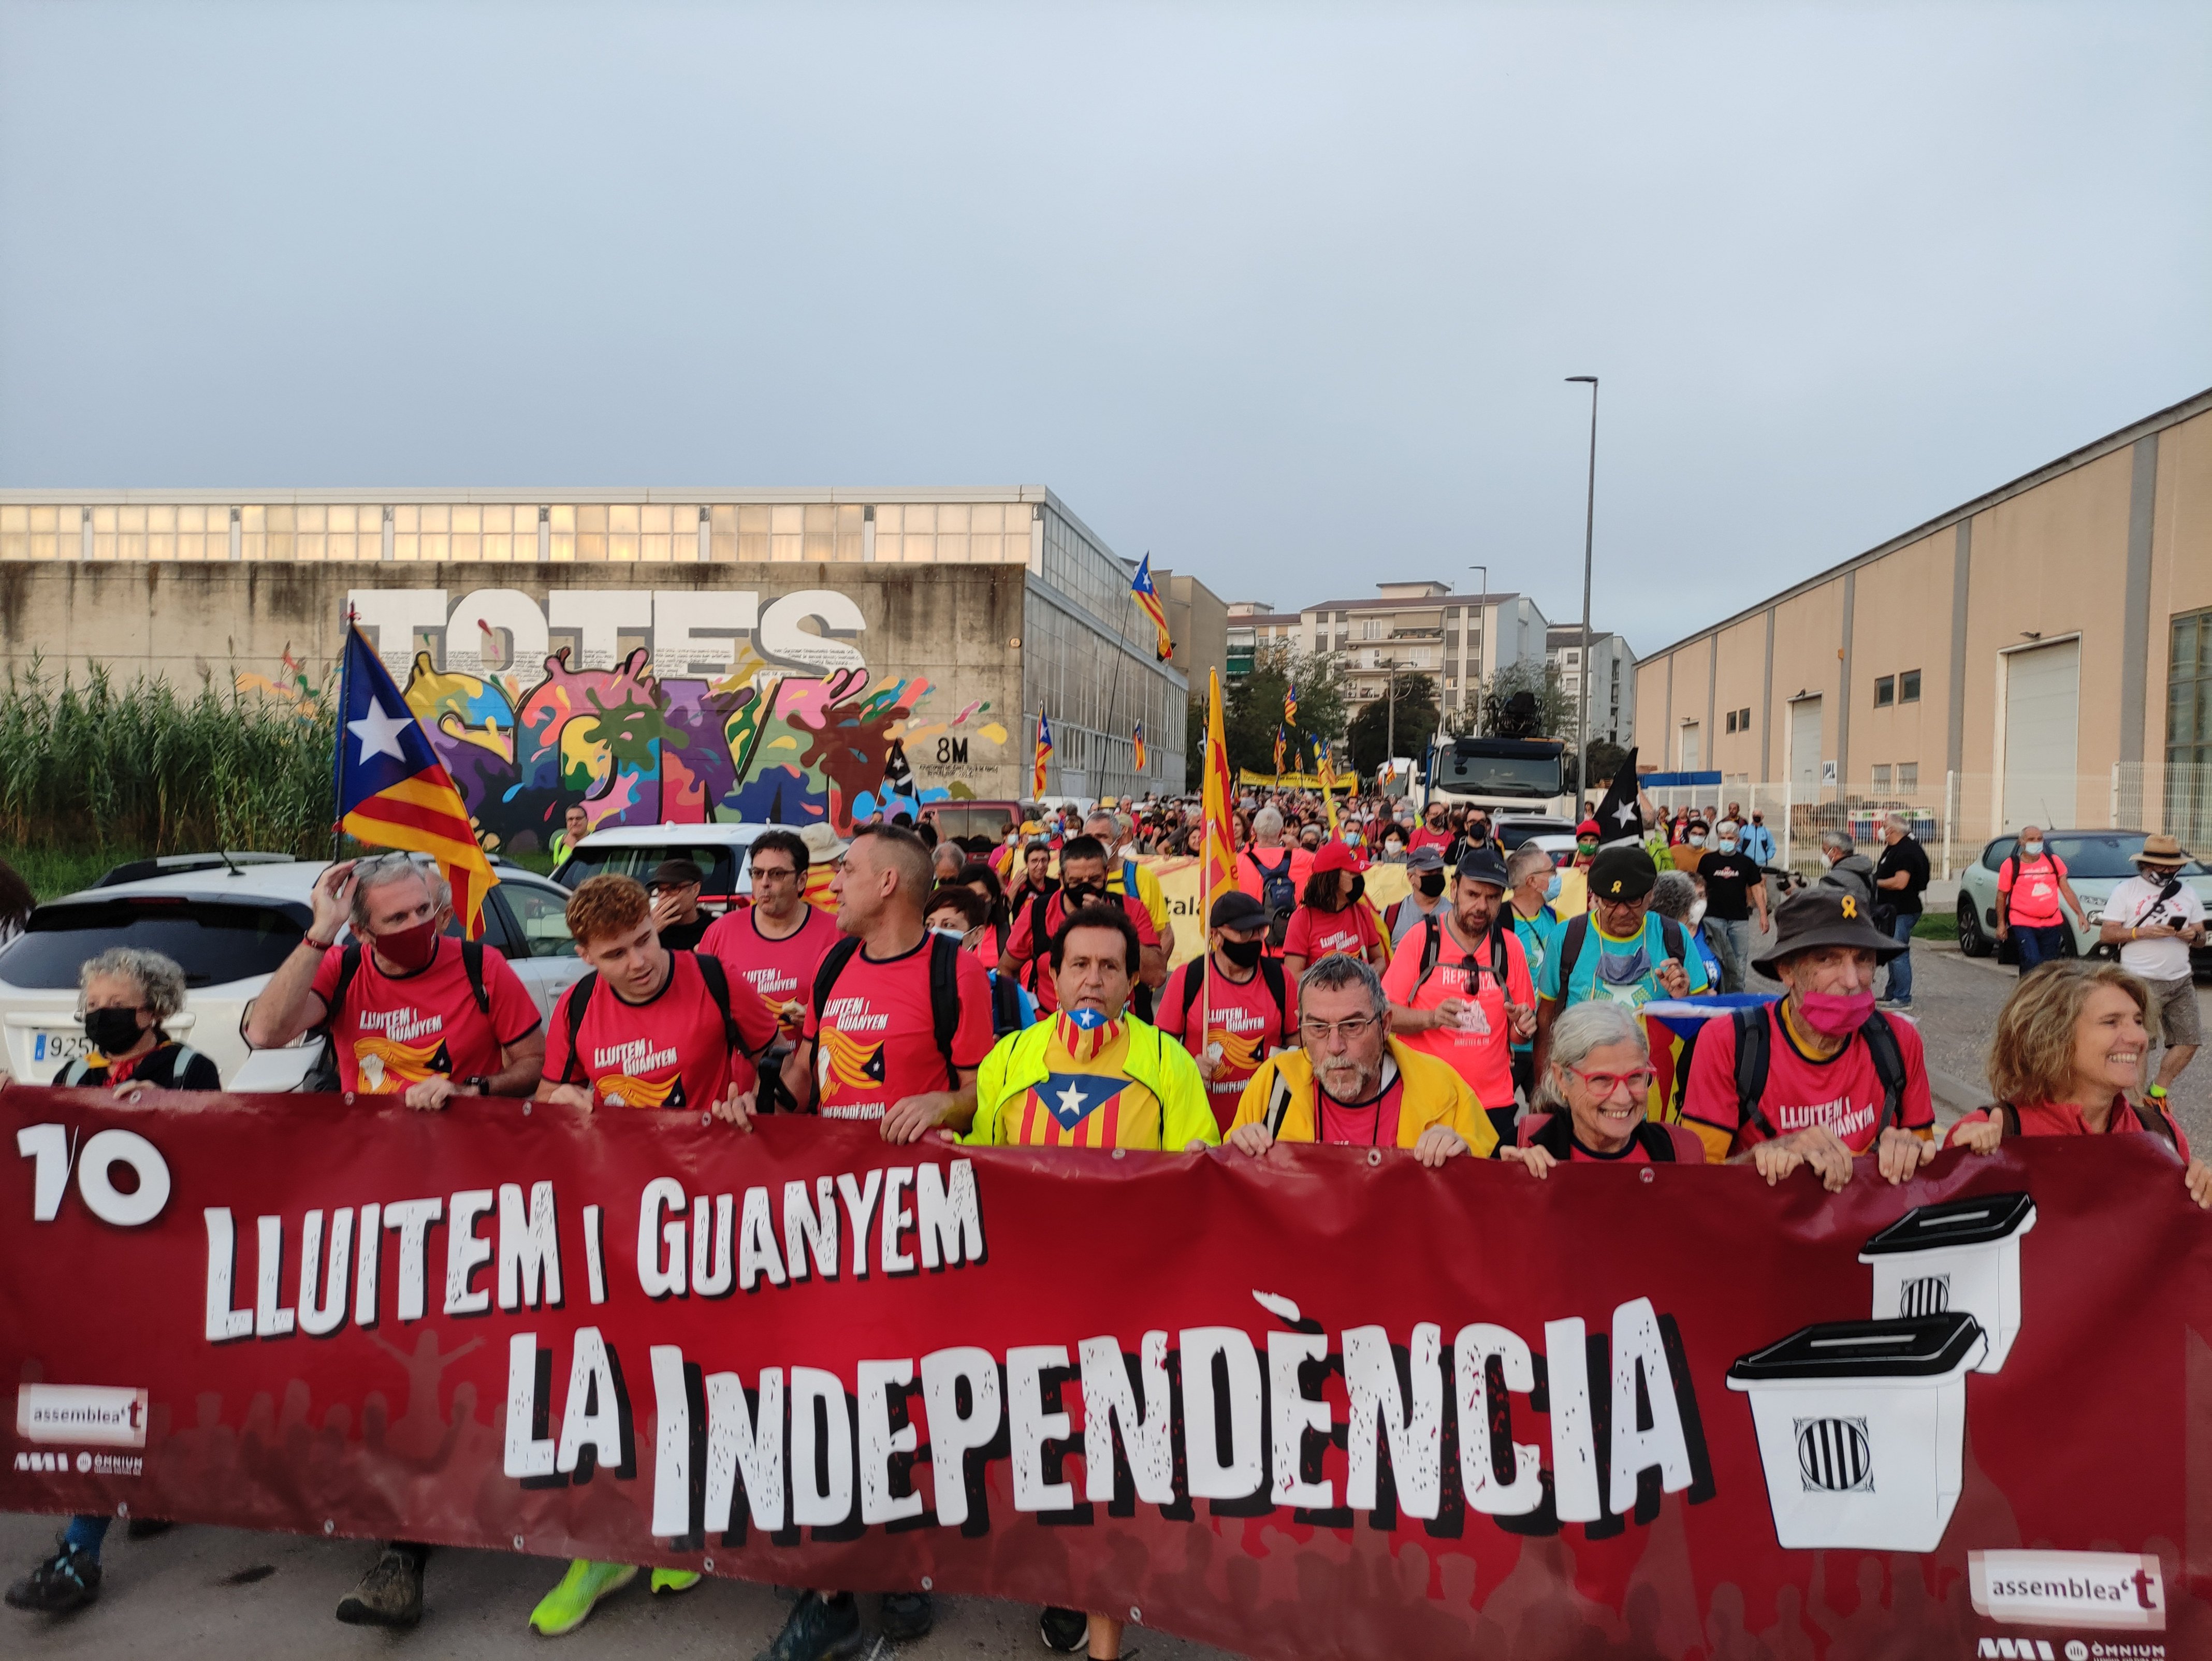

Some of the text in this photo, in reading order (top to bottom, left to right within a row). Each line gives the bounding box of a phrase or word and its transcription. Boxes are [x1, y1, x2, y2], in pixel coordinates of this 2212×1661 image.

[347, 589, 867, 684] TOTES
[937, 737, 968, 763] 8M
[359, 1007, 411, 1030] LLUITEM
[386, 1014, 442, 1042] GUANYEM
[51, 1037, 95, 1059] 925
[594, 1038, 646, 1069] LLUITEM
[623, 1046, 677, 1077] GUANYEM
[1780, 1096, 1843, 1129] LLUITEM
[204, 1158, 984, 1342] LLUITEM I GUANYEM
[504, 1289, 1694, 1537] LA INDEPENDÈNCIA
[2091, 1640, 2165, 1657] ÒMNIUM
